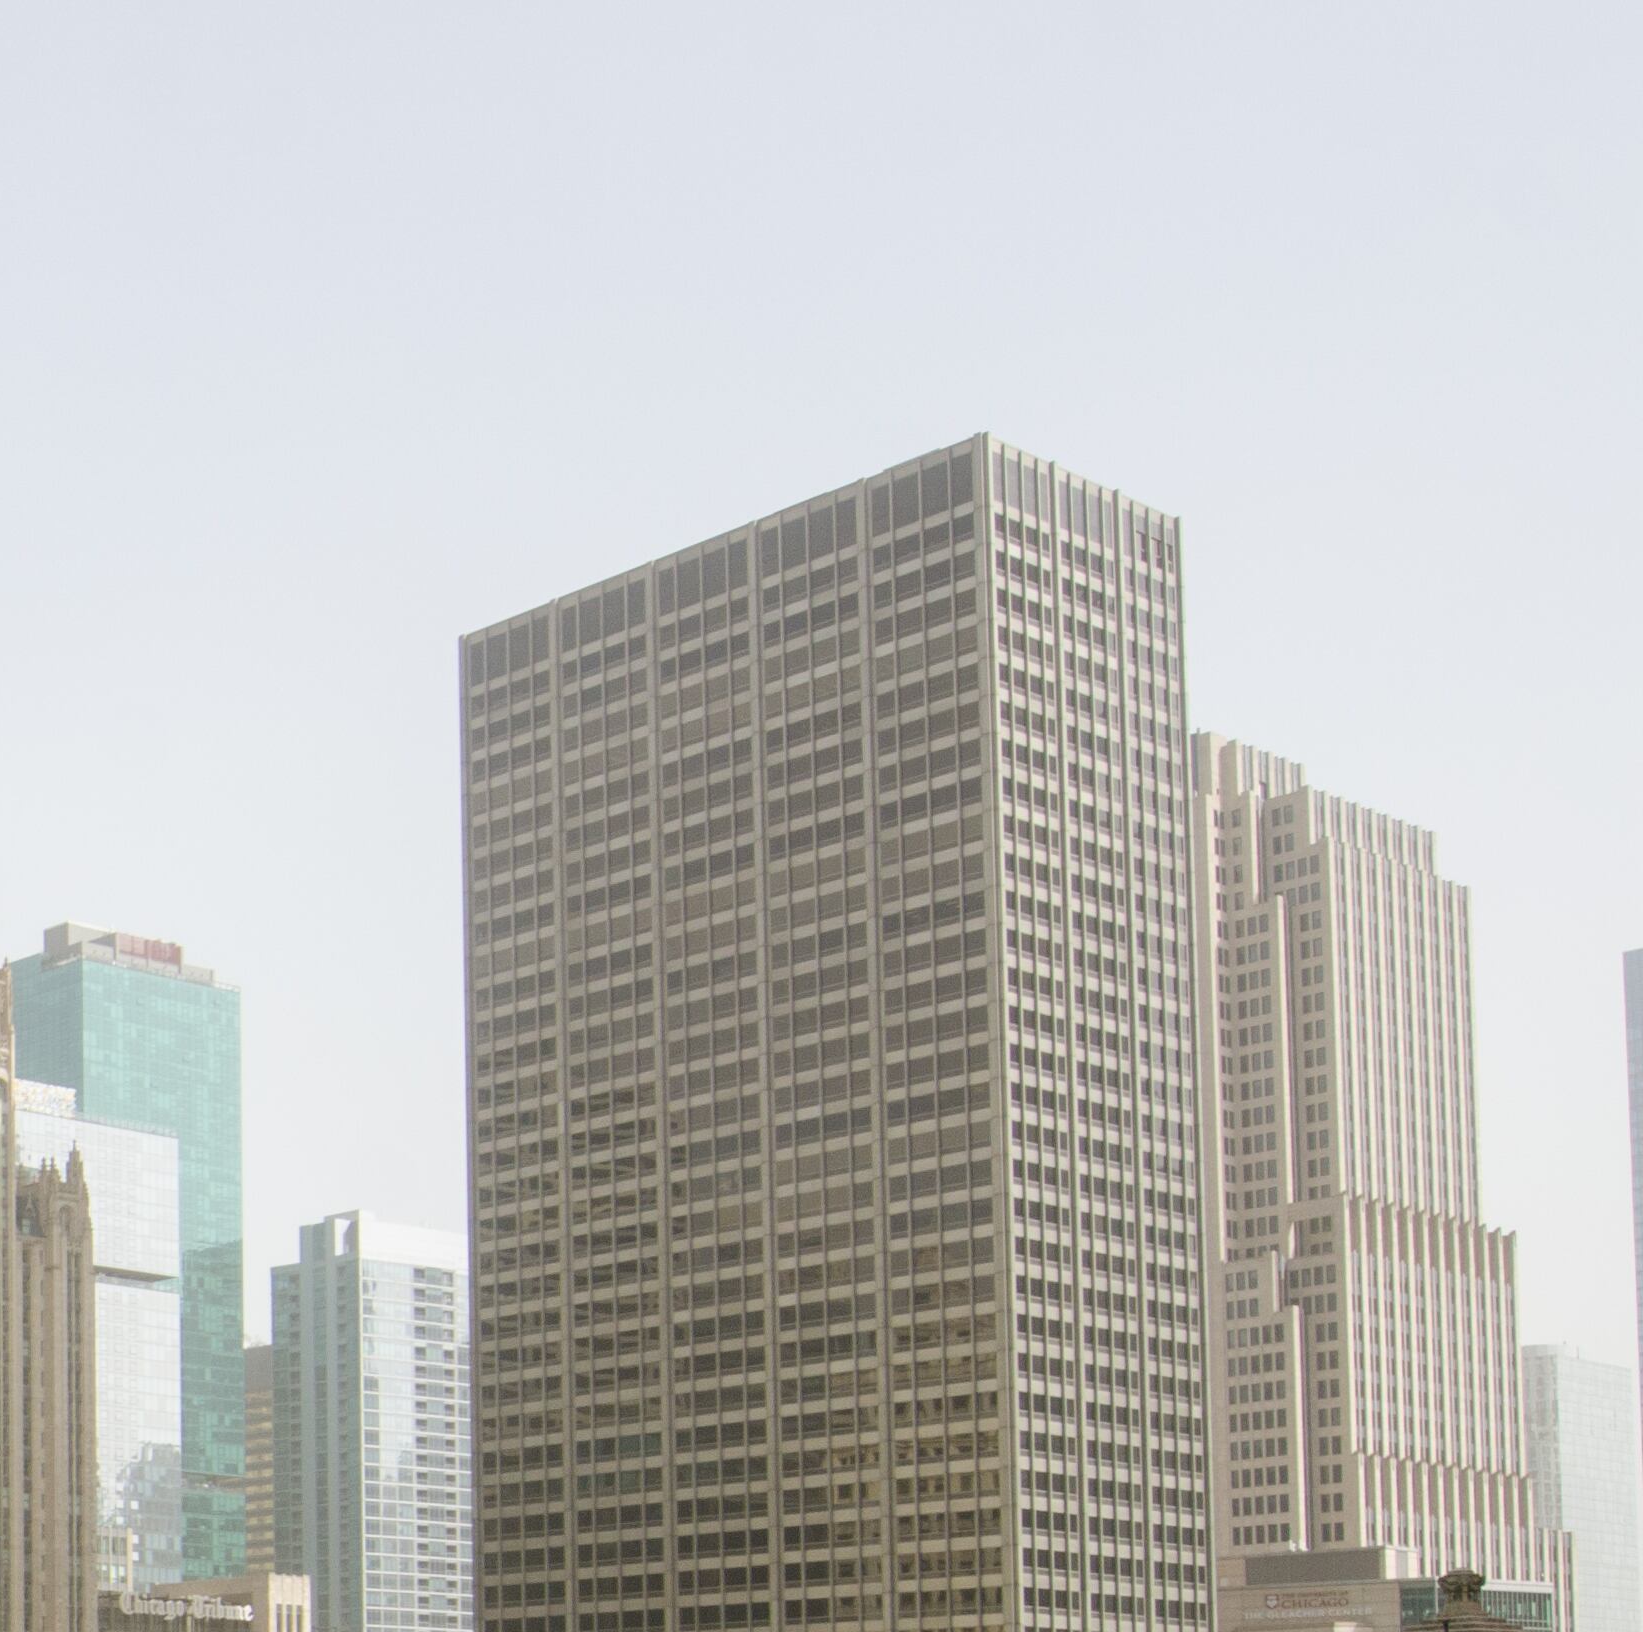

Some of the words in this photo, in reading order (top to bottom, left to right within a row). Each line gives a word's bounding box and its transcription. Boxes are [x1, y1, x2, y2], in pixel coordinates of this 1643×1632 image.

[119, 1592, 186, 1621] Chicago
[187, 1594, 255, 1622] Tribune
[1281, 1598, 1349, 1609] CHICAGO
[1328, 1605, 1372, 1617] CENTER
